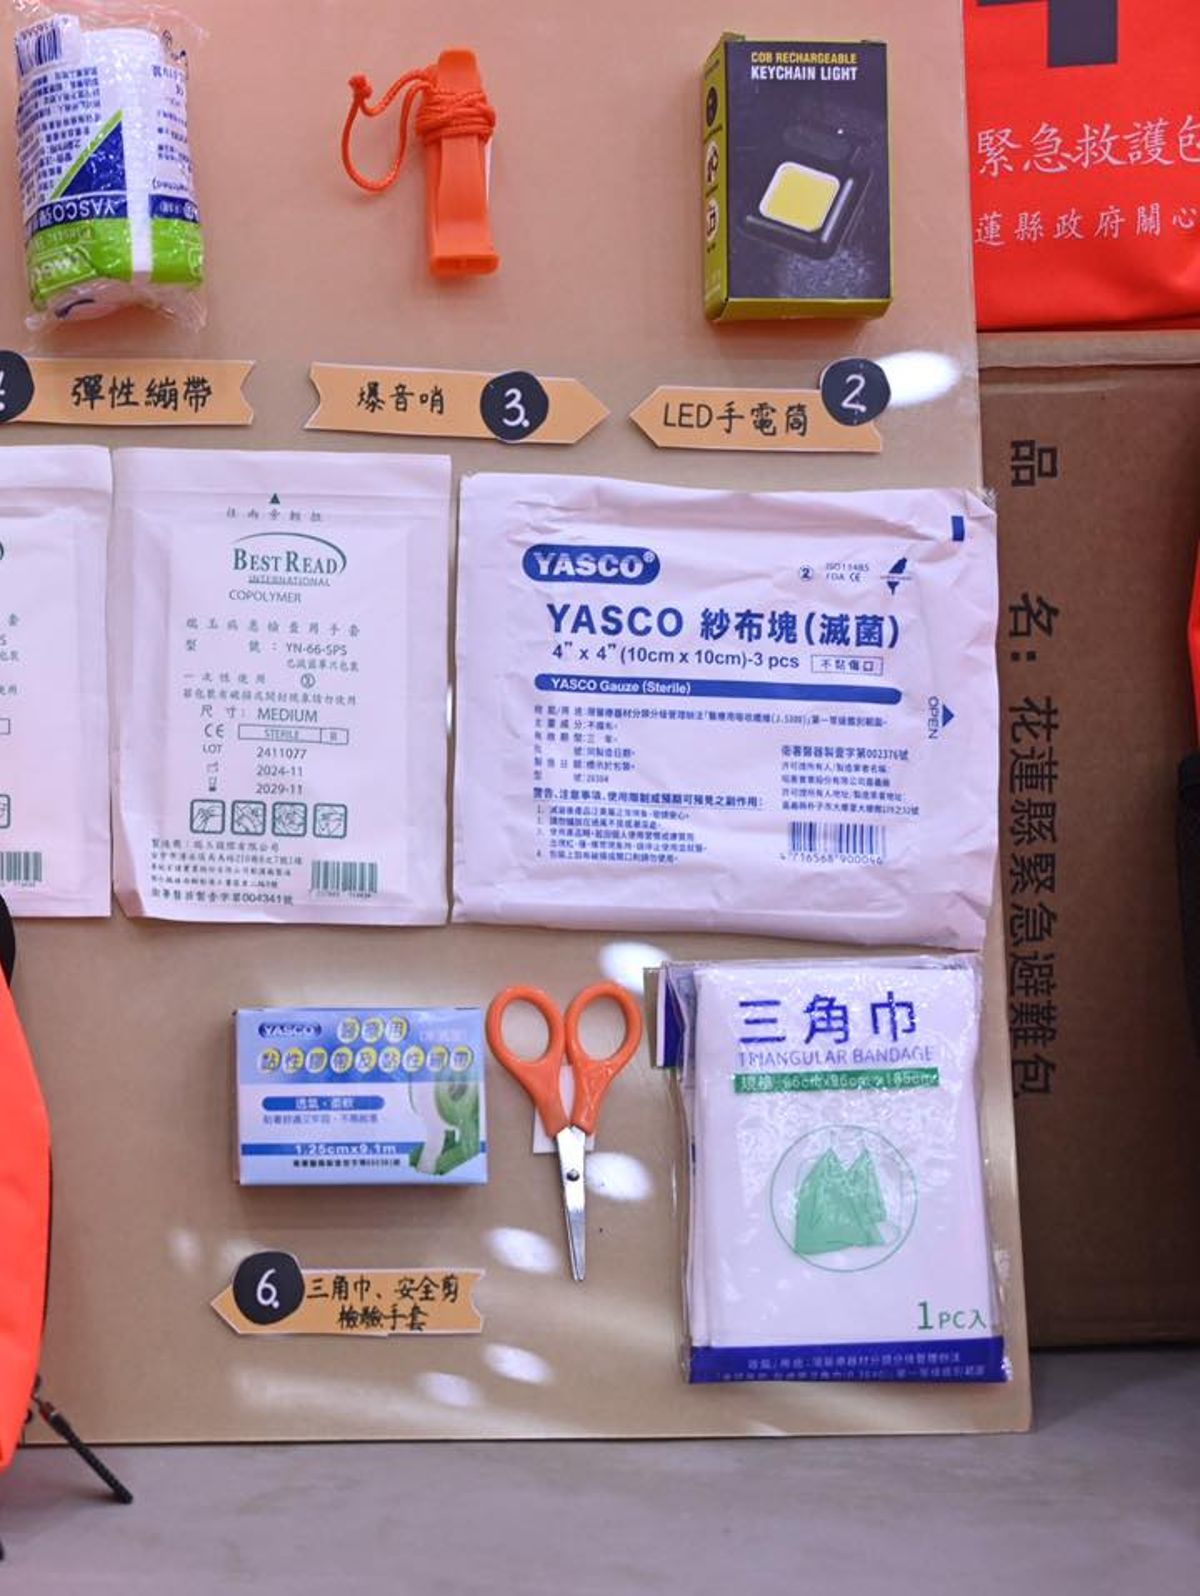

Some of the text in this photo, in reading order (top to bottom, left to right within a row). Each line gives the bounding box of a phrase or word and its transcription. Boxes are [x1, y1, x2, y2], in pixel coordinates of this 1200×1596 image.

[751, 51, 858, 65] COB RECHARGEABLE
[751, 65, 859, 81] KEYCHAIN LIGHT
[71, 374, 213, 415] 彈性繃帶
[356, 382, 446, 415] 爆音哨
[662, 403, 810, 436] LED手電筒
[533, 552, 644, 578] YASCO
[229, 588, 302, 604] COPOLYMER
[546, 602, 899, 649] YASCO 紗布塊(滅菌)
[579, 650, 589, 661] x
[620, 648, 675, 666] (10cm
[679, 652, 689, 664] x
[767, 656, 800, 670] pcs
[550, 678, 692, 695] YASCO Gauze (Sterile)
[256, 706, 319, 723] MEDIUM
[927, 695, 940, 740] OPEN
[201, 743, 308, 760] LOT 2411077
[255, 764, 304, 778] 2024-11
[255, 783, 304, 796] 2029-11
[738, 991, 917, 1044] 三角巾
[852, 1046, 935, 1064] BANDAGE
